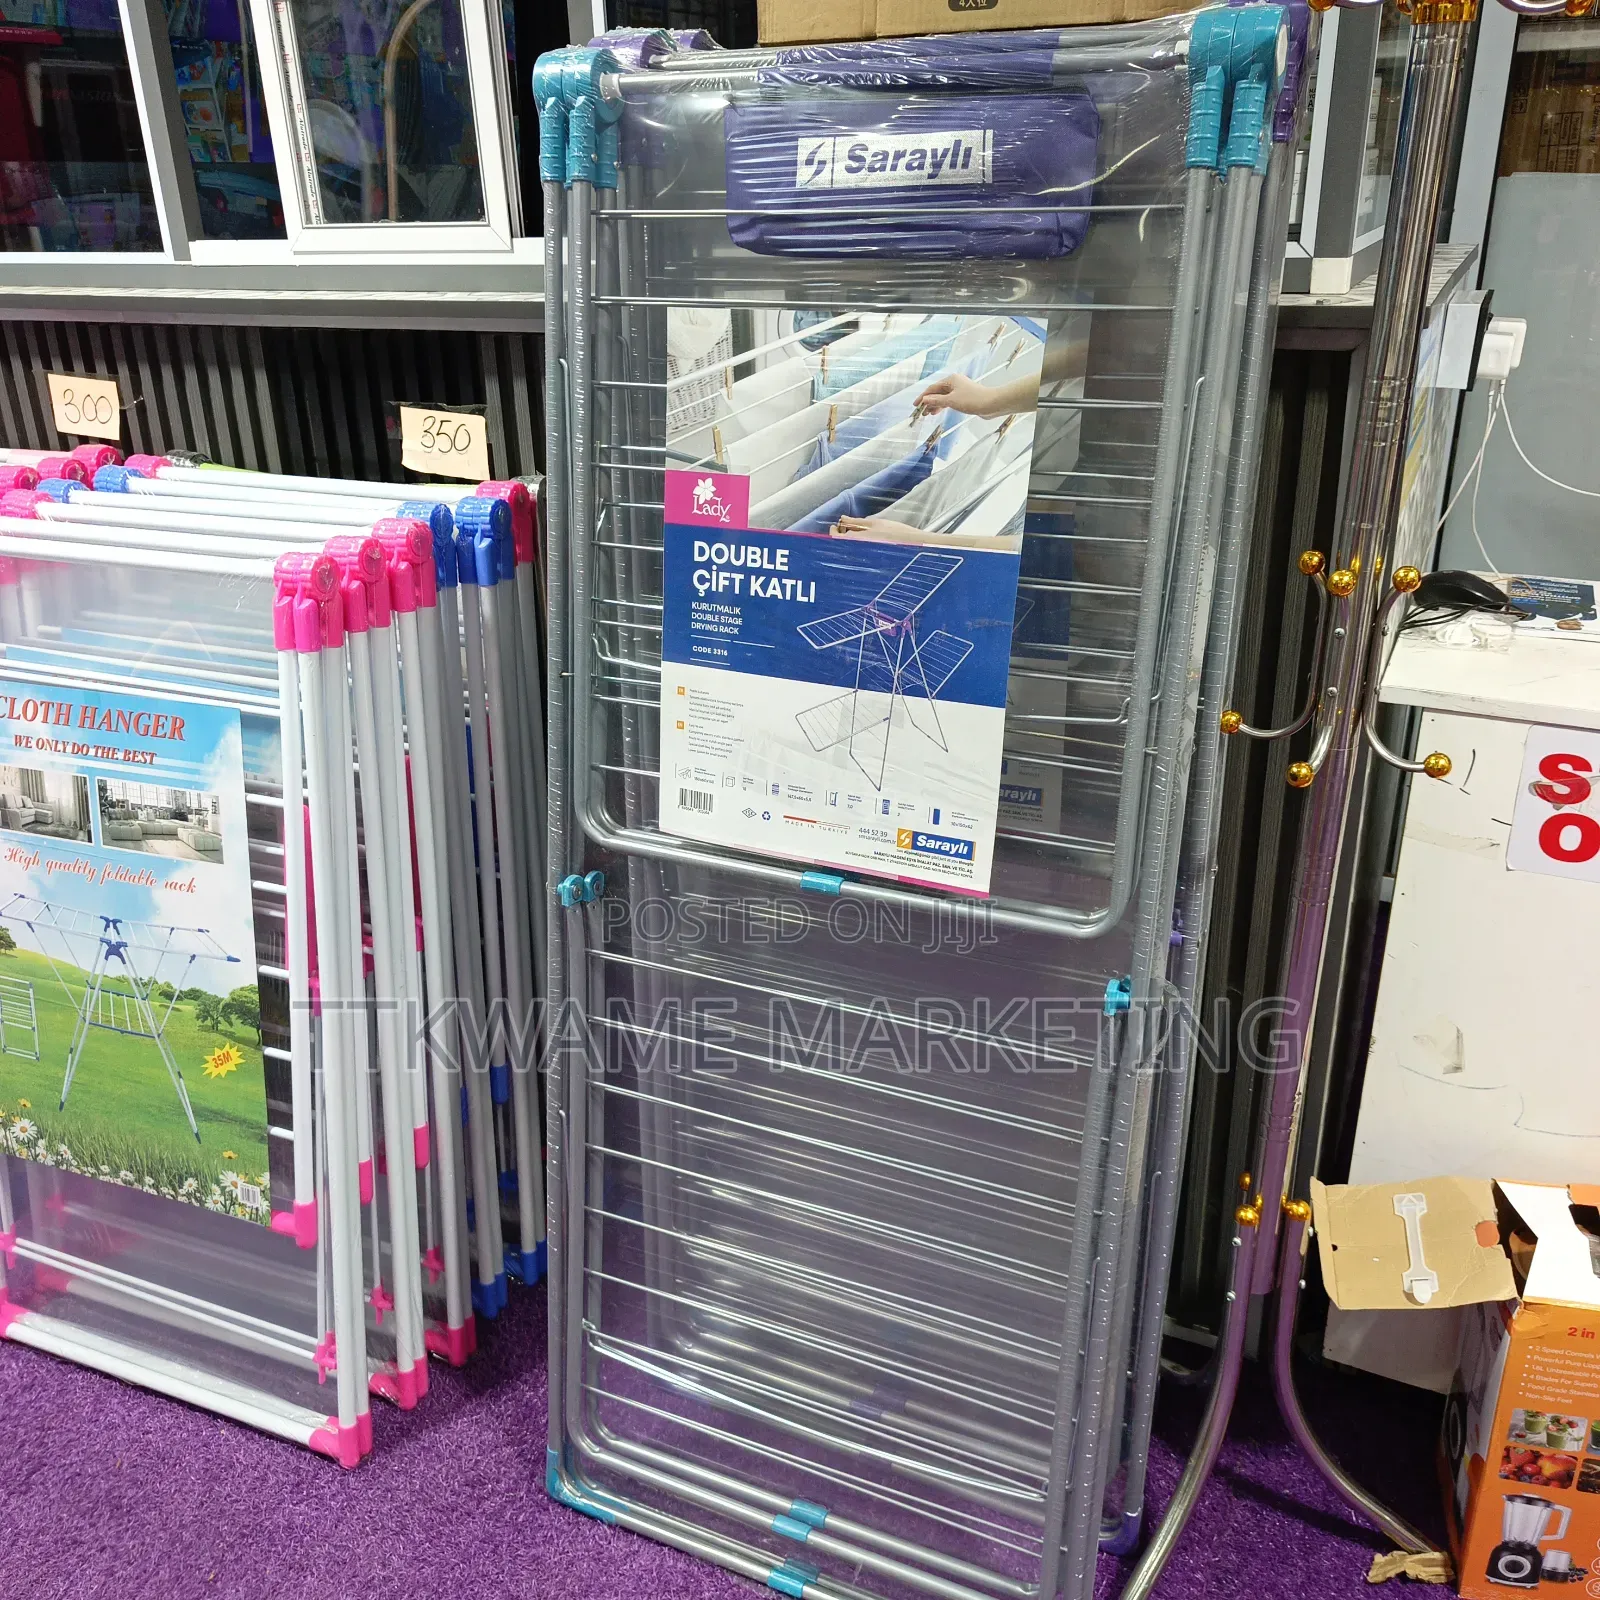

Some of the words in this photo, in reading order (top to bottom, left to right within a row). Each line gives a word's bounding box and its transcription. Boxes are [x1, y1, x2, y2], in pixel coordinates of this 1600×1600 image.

[299, 118, 308, 151] Alutrade
[844, 139, 973, 179] Saraylı
[307, 166, 316, 198] Alutrade
[63, 388, 112, 424] 300
[420, 416, 471, 454] 350
[692, 494, 732, 522] Lady
[694, 540, 790, 572] DOUBLE
[692, 564, 744, 597] ÇİFT
[750, 575, 816, 603] KATLI
[692, 602, 742, 615] KURUTMALIK
[692, 612, 720, 622] DOUBLE
[720, 616, 742, 626] STAGE
[692, 622, 718, 632] DRYING
[720, 626, 739, 634] RACK
[692, 645, 712, 654] CODE
[78, 704, 186, 742] HANGER
[14, 734, 33, 749] WE
[36, 737, 70, 754] ONLY
[71, 741, 90, 756] DO
[93, 745, 119, 760] THE
[123, 750, 157, 765] BEST
[999, 789, 1037, 802] araylı
[916, 835, 969, 855] Saraylı
[1539, 813, 1600, 863] O
[4, 846, 40, 872] High
[46, 858, 97, 883] quality
[100, 862, 158, 887] foldable
[163, 876, 197, 894] rack
[212, 1050, 233, 1069] 35M
[1567, 1326, 1578, 1337] 2
[1581, 1328, 1595, 1339] in
[1534, 1355, 1564, 1364] Powerful
[1565, 1350, 1594, 1358] Controls
[1536, 1375, 1559, 1383] Blades
[1574, 1380, 1598, 1388] Superb
[1547, 1367, 1590, 1377] Unbreakable
[1526, 1392, 1555, 1402] Non-Slip
[1569, 1389, 1599, 1398] Stainless
